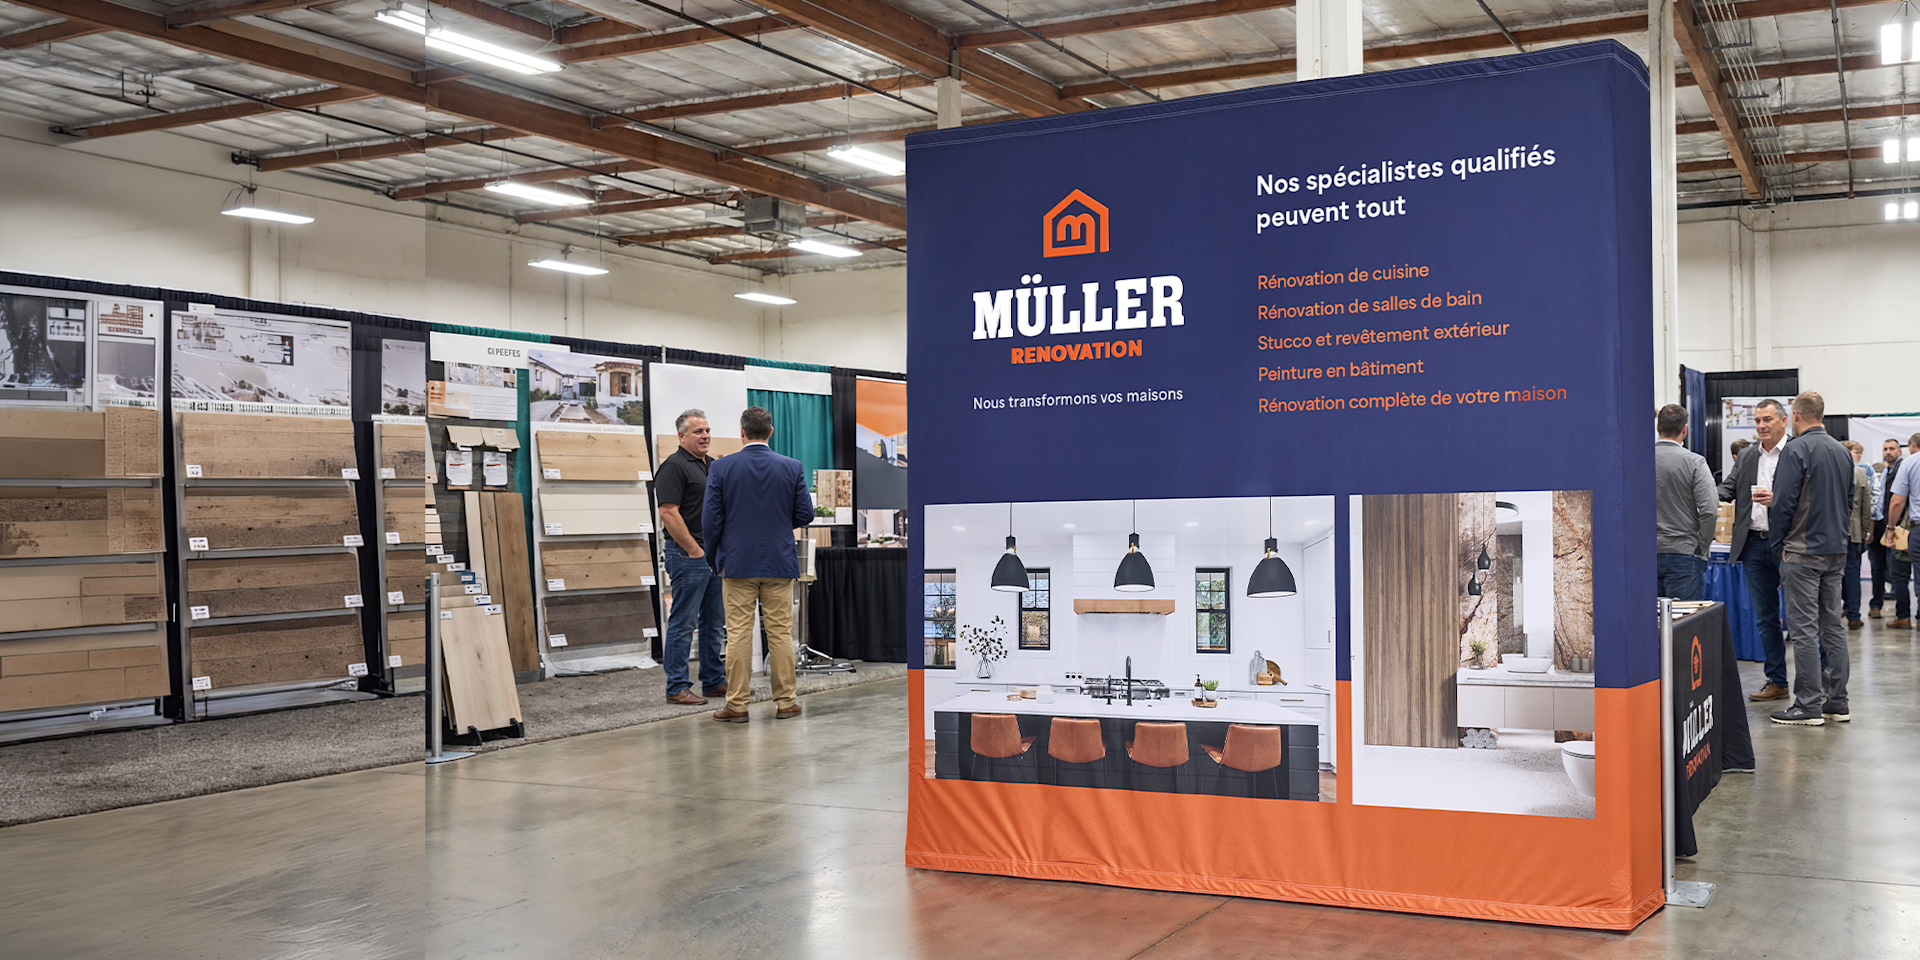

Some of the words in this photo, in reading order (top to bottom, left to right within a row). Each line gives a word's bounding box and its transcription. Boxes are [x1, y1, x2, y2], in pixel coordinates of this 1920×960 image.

[1256, 173, 1300, 196] Nos
[1305, 160, 1444, 195] spécialistes
[1450, 143, 1556, 181] qualifiés
[1256, 201, 1350, 235] peuvent
[1355, 195, 1407, 219] tout
[1257, 269, 1345, 290] Rénovation
[1347, 267, 1369, 283] de
[1372, 263, 1430, 281] cuisine
[972, 273, 1185, 340] MÜLLER
[1258, 300, 1345, 321] Rénovation
[1347, 298, 1369, 314] de
[1372, 295, 1417, 312] salles
[1420, 292, 1443, 309] de
[1446, 289, 1483, 307] bain
[1257, 335, 1313, 351] Stucco
[1315, 332, 1333, 347] et
[1335, 325, 1430, 346] revêtement
[1433, 321, 1510, 340] extérieur
[1010, 339, 1143, 365] RENOVATION
[1258, 365, 1323, 382] Peinture
[1325, 365, 1346, 379] en
[1349, 359, 1425, 377] bâtiment
[973, 396, 1006, 410] Nous
[1008, 393, 1098, 408] transformons
[1100, 392, 1123, 404] vos
[1126, 388, 1184, 403] maisons
[1258, 395, 1345, 414] Rénovation
[1348, 391, 1427, 412] complète
[1430, 389, 1453, 406] de
[1455, 388, 1501, 405] votre
[1504, 385, 1567, 403] maison
